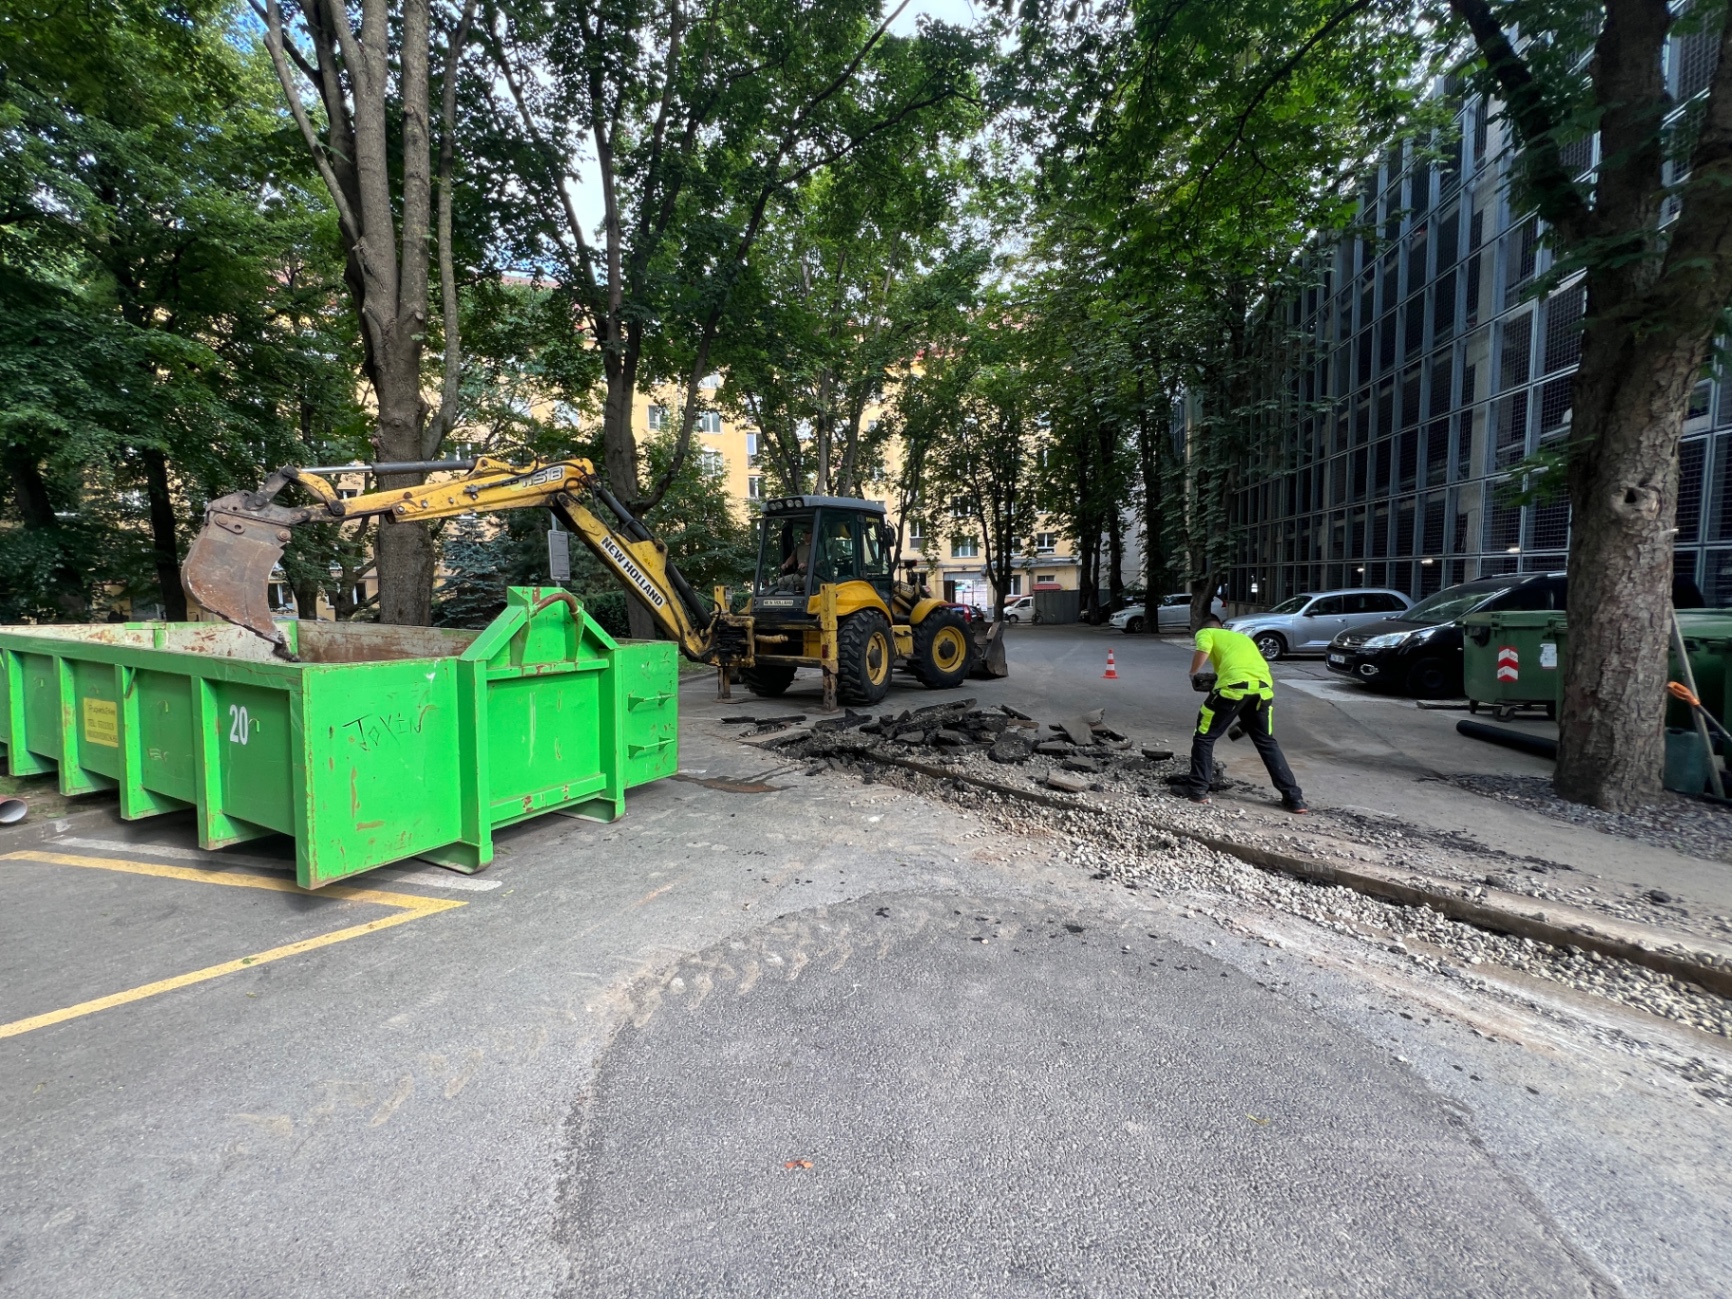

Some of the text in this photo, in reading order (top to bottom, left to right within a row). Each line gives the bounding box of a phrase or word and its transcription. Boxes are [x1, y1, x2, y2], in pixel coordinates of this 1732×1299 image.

[601, 536, 663, 606] NEW HOLLAND
[229, 704, 249, 746] 20
